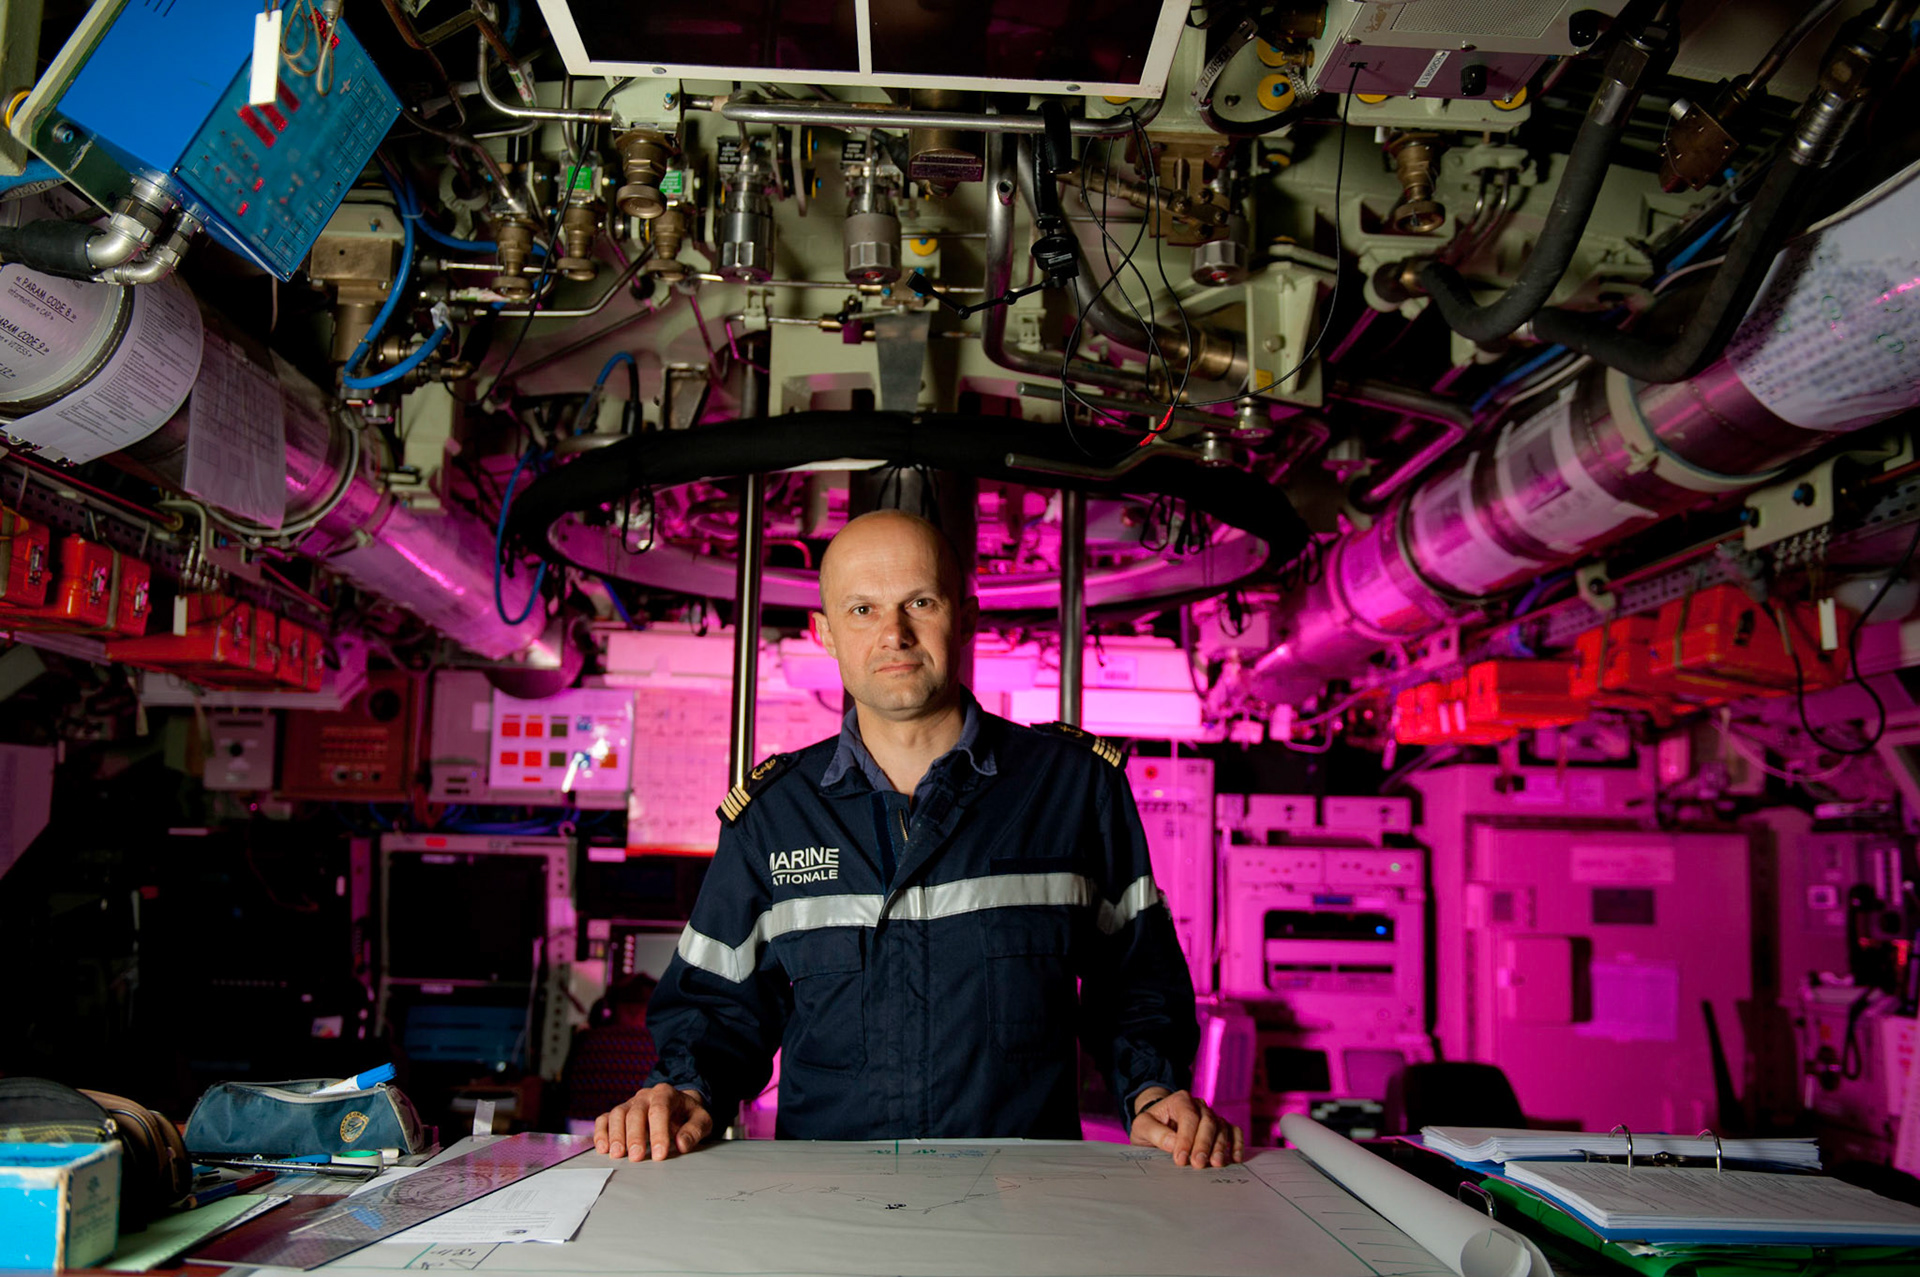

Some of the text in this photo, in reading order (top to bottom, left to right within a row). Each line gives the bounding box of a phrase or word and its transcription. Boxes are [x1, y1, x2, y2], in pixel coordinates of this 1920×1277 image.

[22, 278, 46, 299] PARAM
[46, 295, 66, 314] CODE
[39, 308, 51, 318] CAP
[0, 316, 19, 334] ARAM
[18, 331, 37, 347] CODE
[36, 340, 44, 349] 9
[773, 869, 839, 886] ATIONALE
